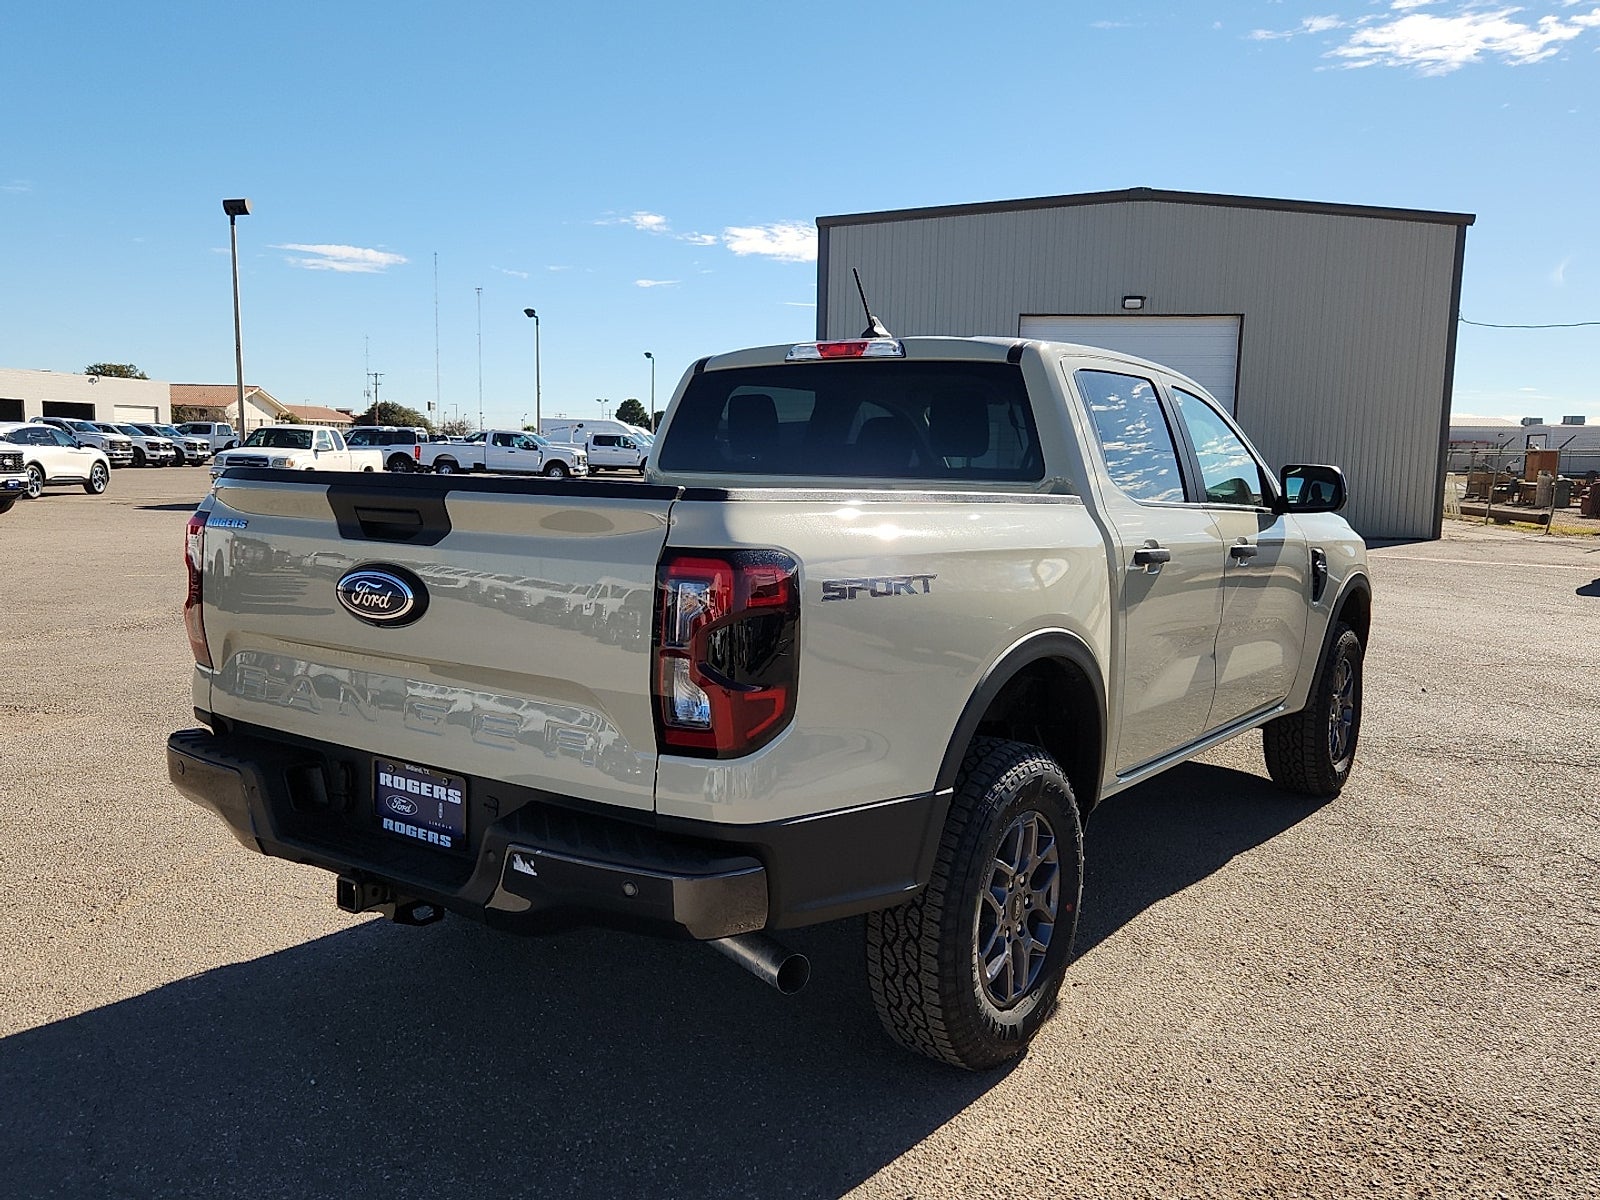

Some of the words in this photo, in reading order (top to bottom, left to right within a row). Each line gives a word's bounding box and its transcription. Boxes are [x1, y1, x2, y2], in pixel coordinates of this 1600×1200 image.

[206, 518, 248, 529] ROGERS
[351, 581, 392, 609] Ford
[821, 574, 938, 602] SPORT
[235, 663, 598, 767] RANGER
[379, 772, 462, 805] ROGERS
[391, 796, 413, 814] Ford
[383, 817, 452, 848] ROGERS
